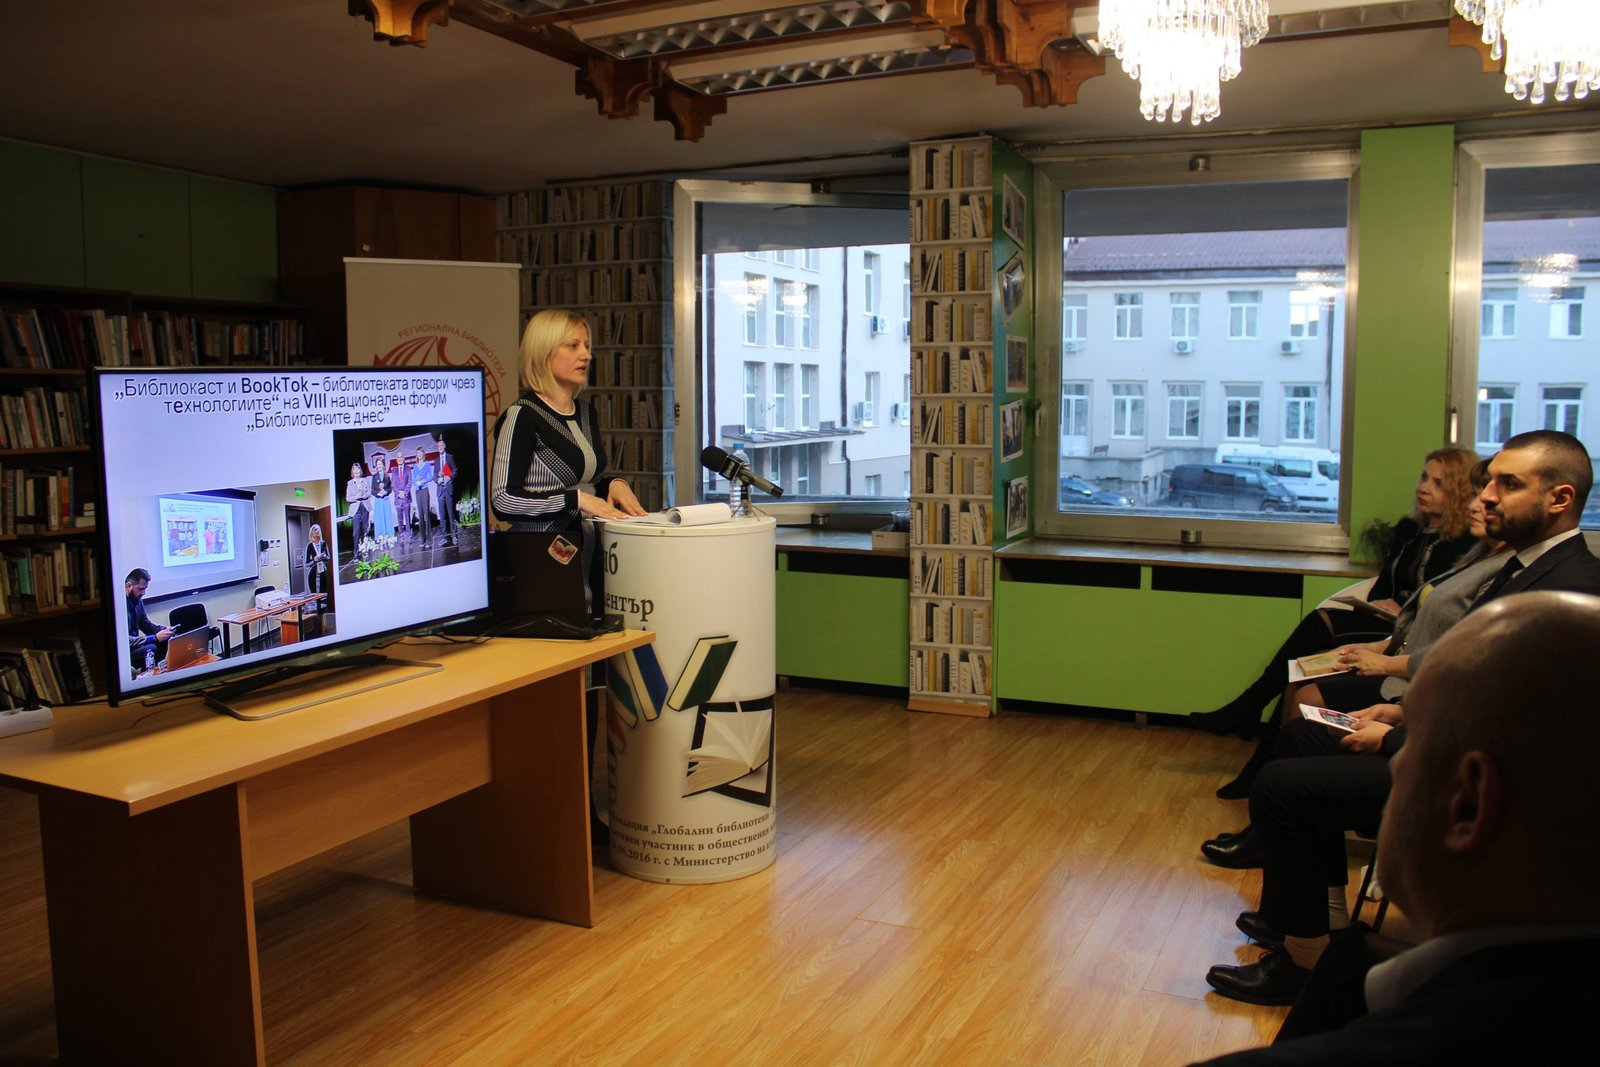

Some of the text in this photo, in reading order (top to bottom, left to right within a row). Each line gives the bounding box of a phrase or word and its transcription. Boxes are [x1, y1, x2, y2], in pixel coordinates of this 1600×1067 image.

[398, 323, 506, 379] РЕГИОНАЛНА БИБЛИОТЕКА
[228, 382, 237, 394] и
[241, 376, 309, 394] BookTok
[323, 376, 409, 392] библиотеката
[411, 378, 449, 392] говори
[451, 378, 476, 392] чрез
[283, 397, 300, 410] на
[303, 393, 327, 409] VIII
[330, 394, 407, 410] национален
[409, 391, 447, 408] форум
[604, 592, 654, 622] ентър
[716, 812, 769, 833] библиотеки
[642, 839, 695, 851] участник
[653, 857, 661, 865] г.
[664, 858, 670, 866] с
[673, 849, 756, 866] Министерство
[757, 844, 766, 854] на
